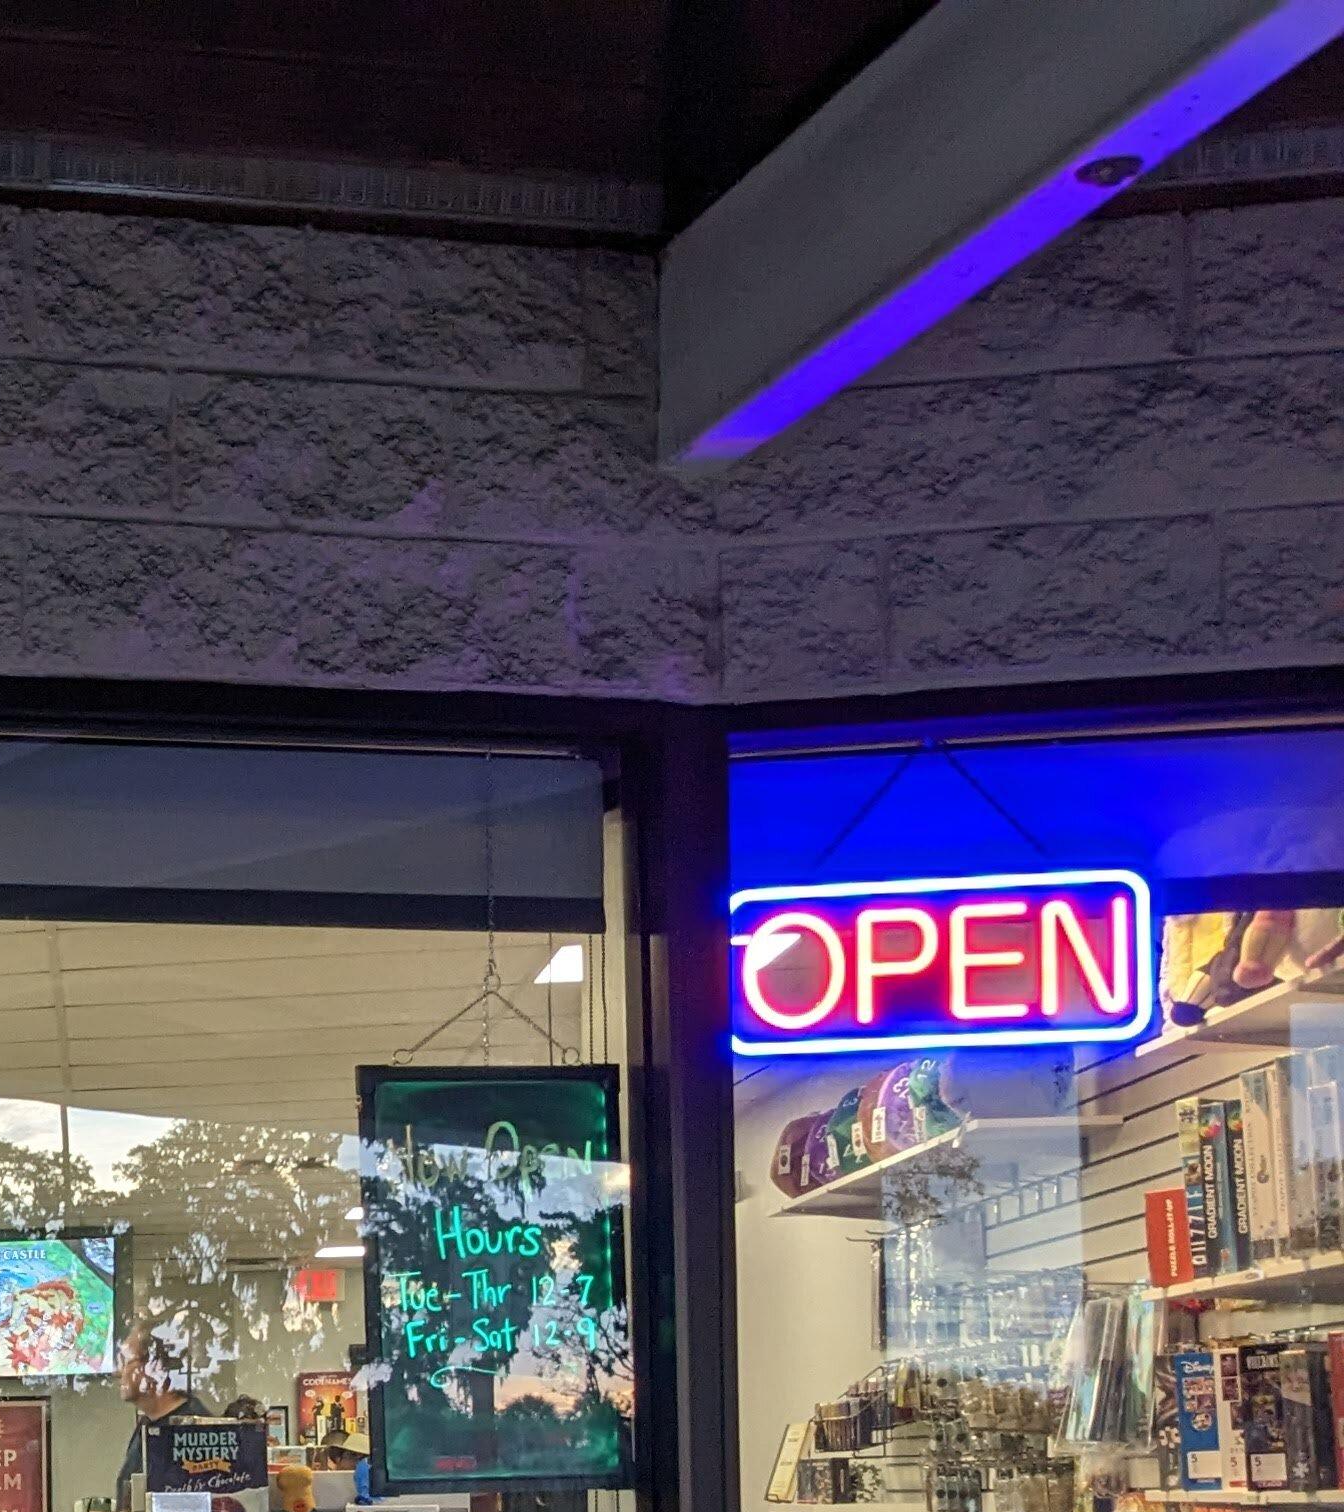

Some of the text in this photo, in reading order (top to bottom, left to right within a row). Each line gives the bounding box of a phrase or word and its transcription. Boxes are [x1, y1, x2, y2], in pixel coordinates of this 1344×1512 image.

[741, 895, 1131, 1030] OPEN
[1203, 1144, 1218, 1239] GRADIENT MOON
[434, 1204, 542, 1260] Hours
[3, 1249, 47, 1260] CASTLE
[172, 1446, 239, 1461] MYSTERY
[173, 1431, 238, 1447] MURDER
